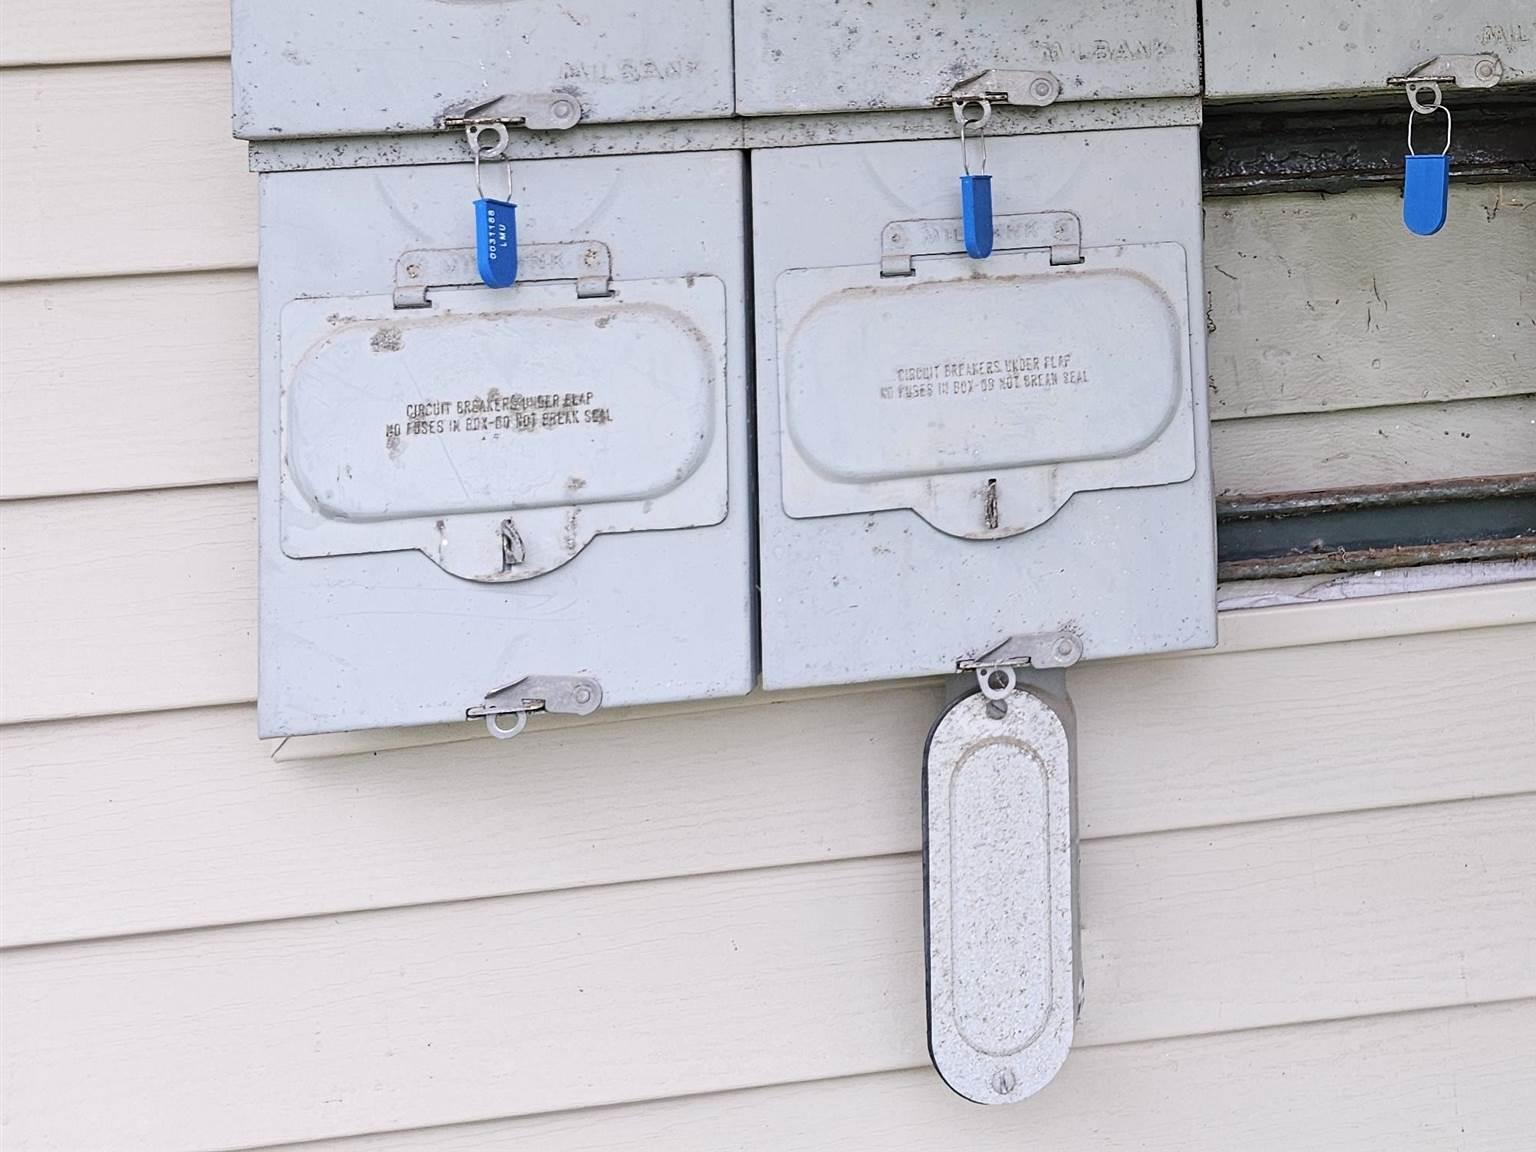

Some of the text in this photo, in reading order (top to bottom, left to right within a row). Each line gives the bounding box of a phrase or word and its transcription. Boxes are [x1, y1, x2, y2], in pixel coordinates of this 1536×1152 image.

[488, 209, 496, 260] 0031188
[499, 223, 507, 247] LMU
[896, 364, 940, 381] CIRCUIT
[406, 401, 451, 419] CIRCUIT
[406, 419, 444, 435] FUSES
